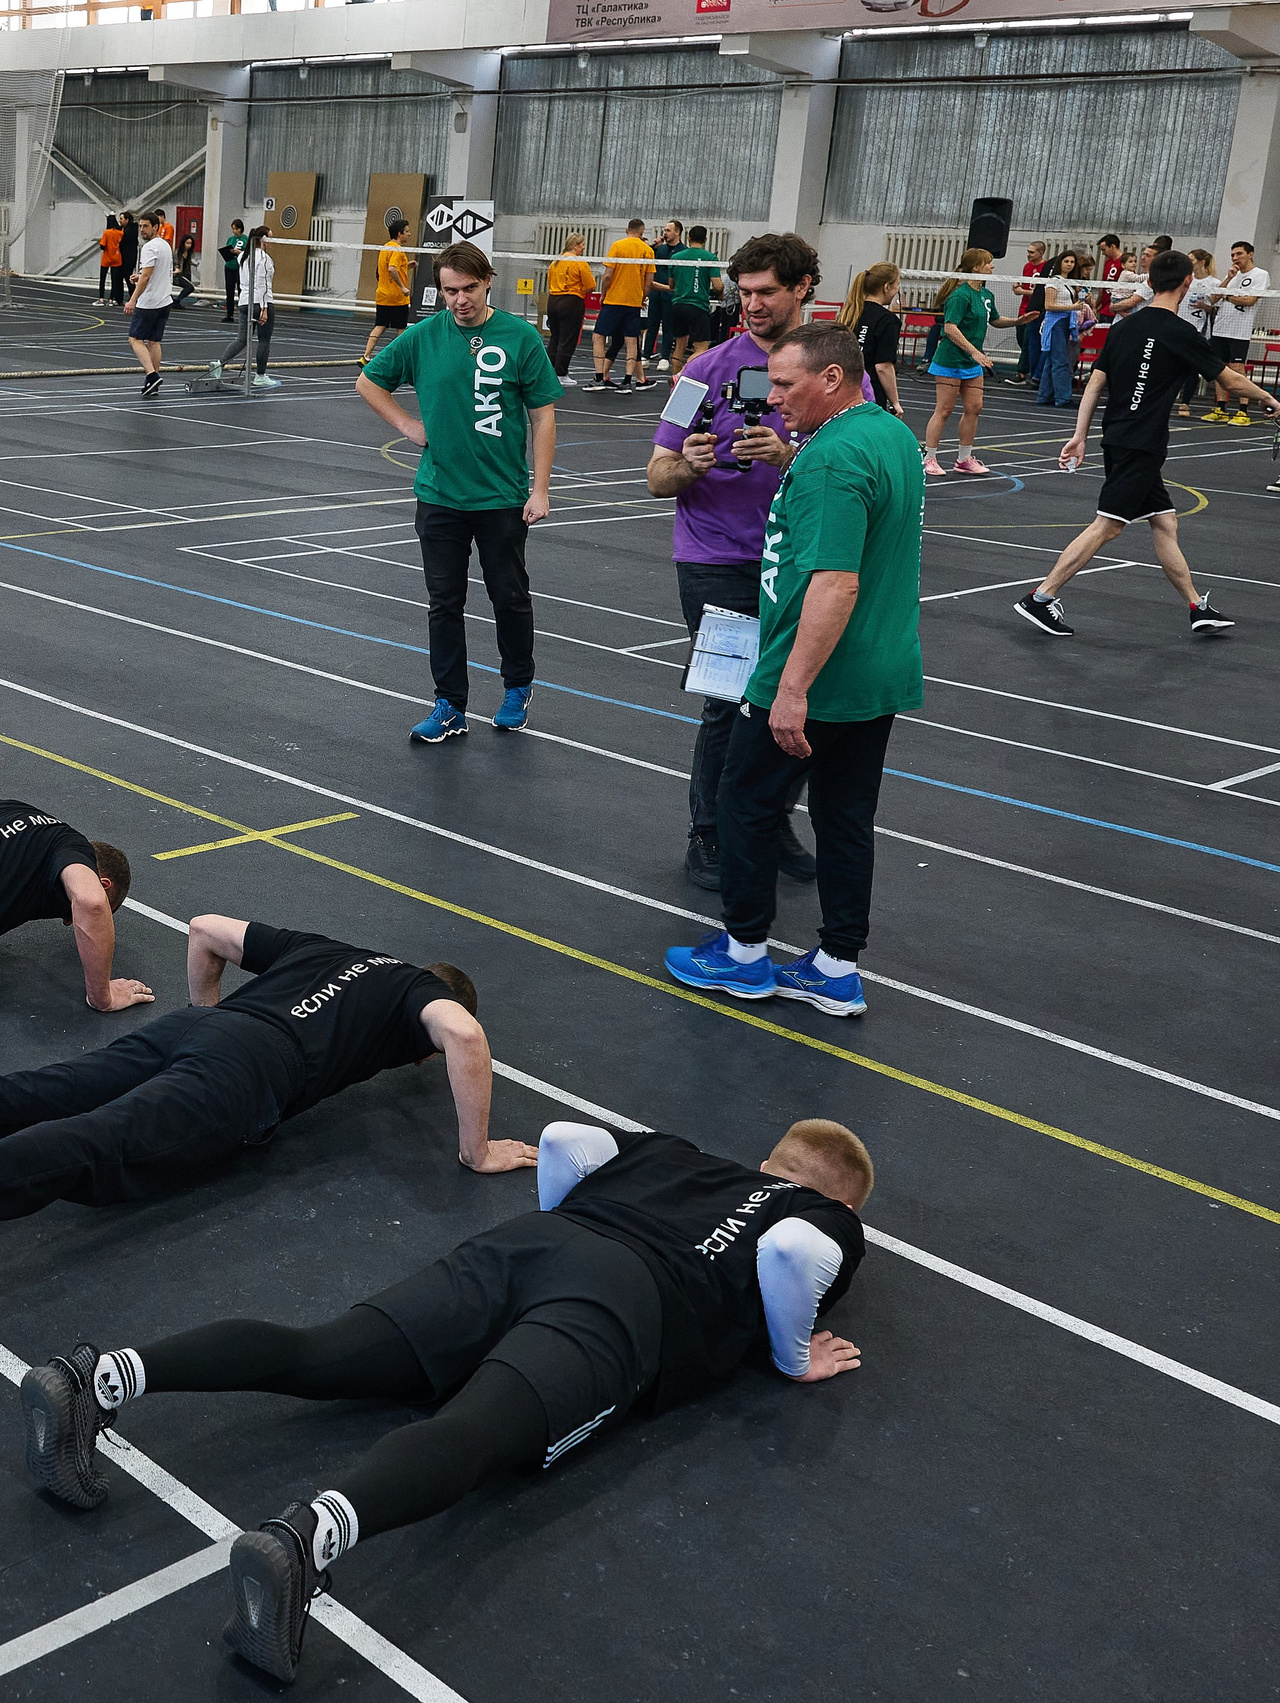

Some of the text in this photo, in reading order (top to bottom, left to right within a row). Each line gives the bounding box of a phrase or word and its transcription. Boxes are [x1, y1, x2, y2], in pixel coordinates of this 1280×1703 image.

[576, 1, 649, 15] ТЦ «Галактика»
[575, 14, 662, 28] ТВК «Республика»
[857, 325, 869, 345] мы
[1138, 362, 1150, 379] не
[1146, 338, 1156, 360] мы
[474, 345, 507, 438] АКТО
[0, 818, 28, 839] не
[290, 956, 404, 1019] если не мы
[735, 1190, 771, 1214] не
